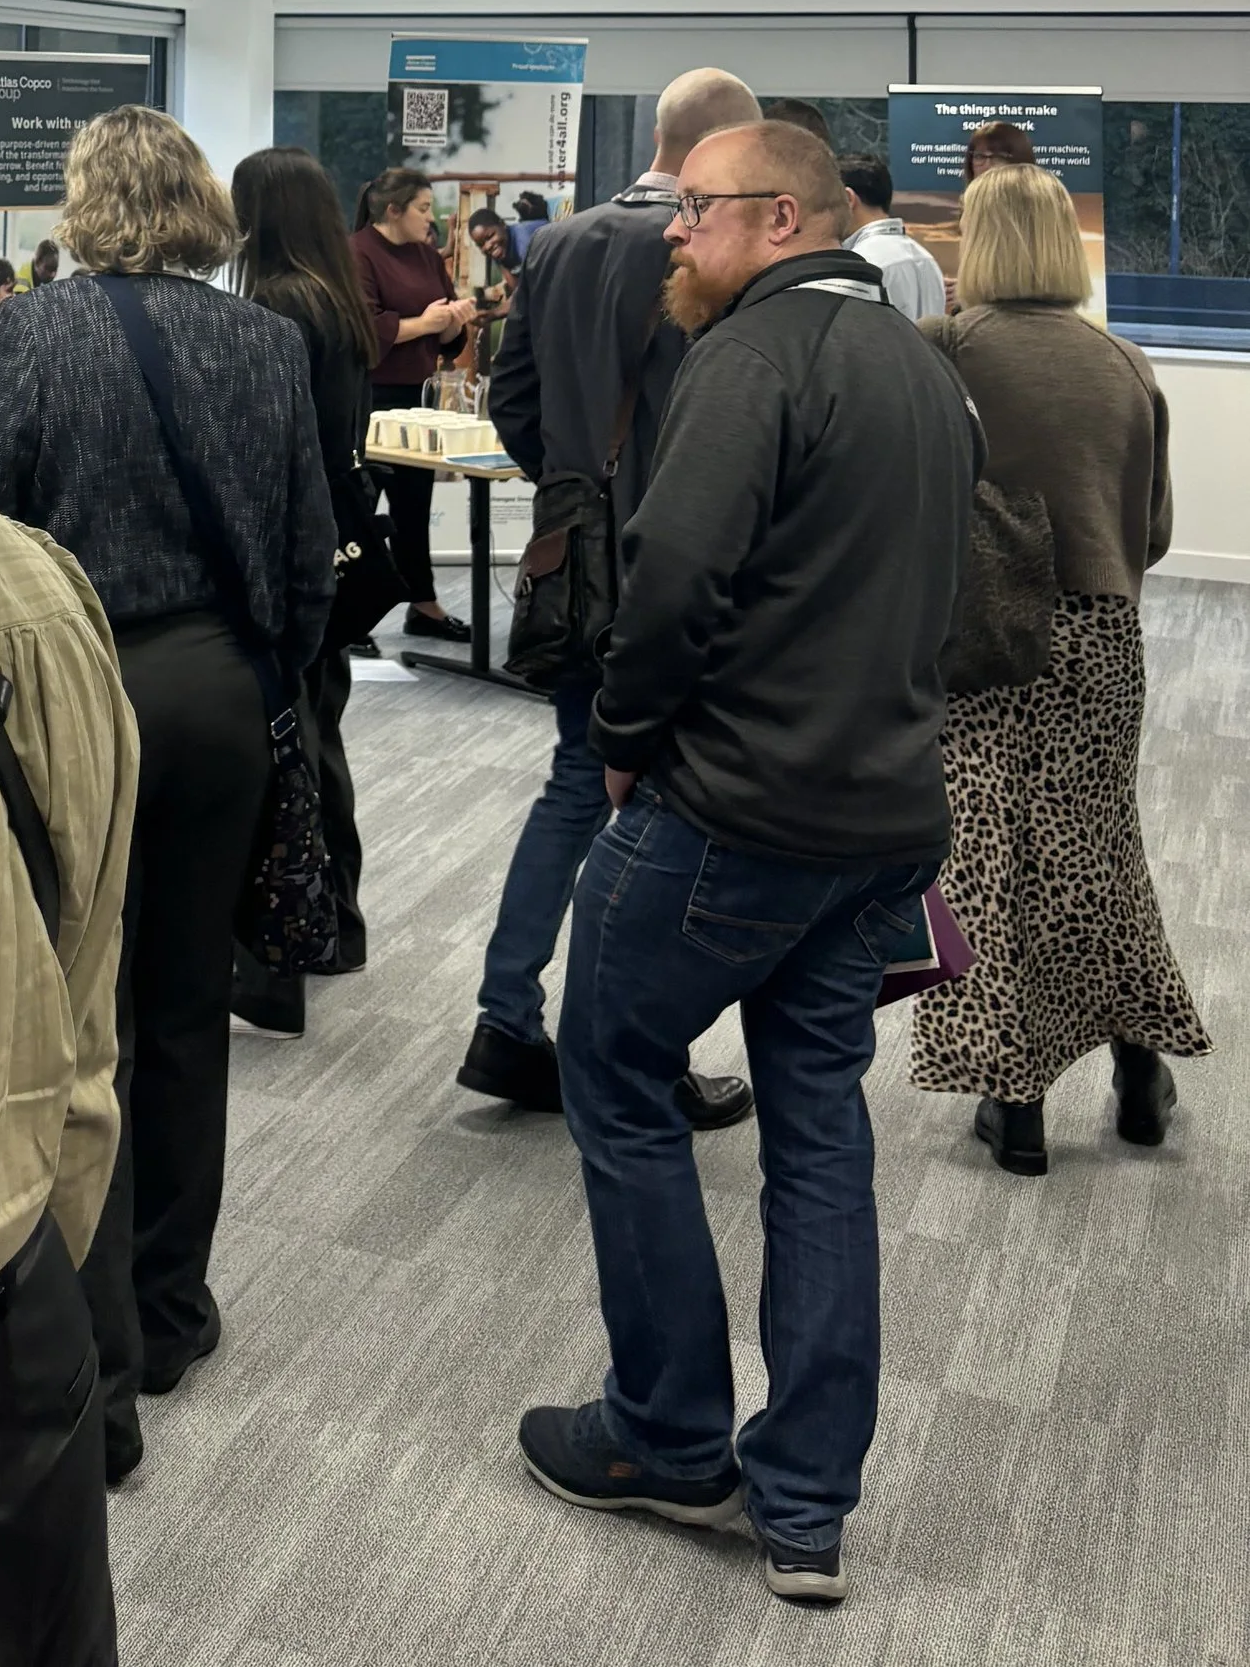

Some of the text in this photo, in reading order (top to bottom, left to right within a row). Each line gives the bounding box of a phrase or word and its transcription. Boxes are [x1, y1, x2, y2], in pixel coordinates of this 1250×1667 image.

[19, 76, 52, 92] Copco
[935, 103, 1057, 117] The things that make
[12, 117, 43, 129] Work
[46, 117, 71, 129] with
[0, 140, 60, 150] purpose-driven
[911, 143, 934, 152] From
[1048, 145, 1090, 154] machines,
[5, 151, 18, 159] the
[911, 156, 1091, 165] our the world
[26, 161, 54, 170] Benefit
[15, 173, 30, 181] and
[24, 183, 39, 192] and
